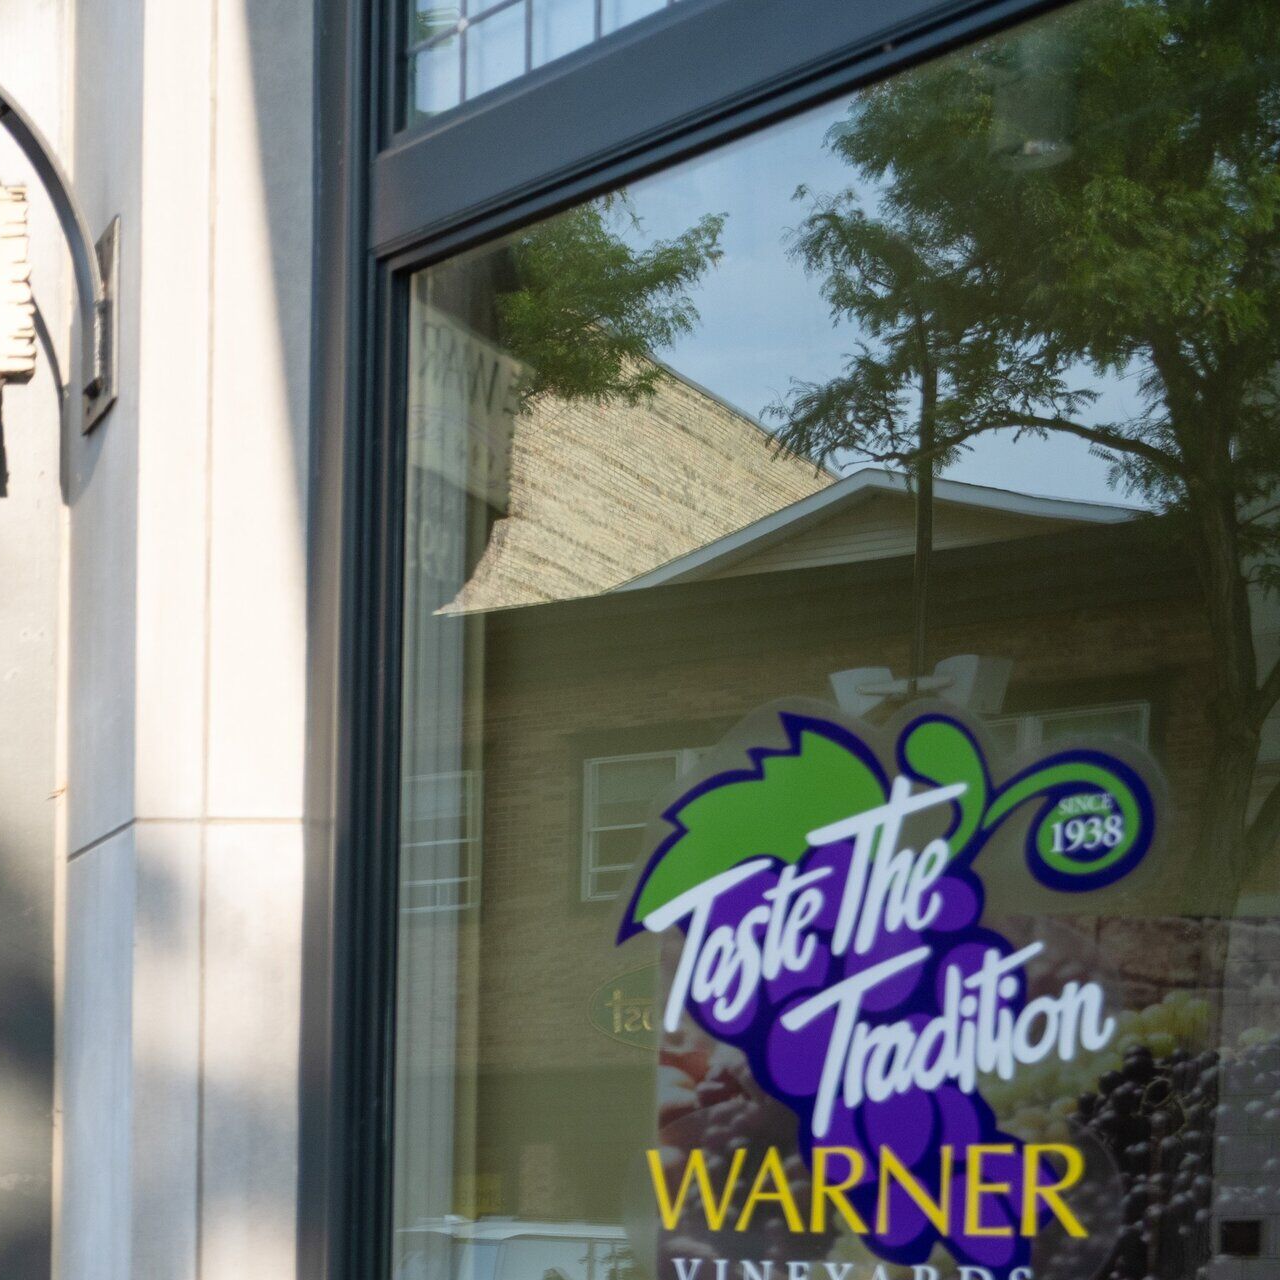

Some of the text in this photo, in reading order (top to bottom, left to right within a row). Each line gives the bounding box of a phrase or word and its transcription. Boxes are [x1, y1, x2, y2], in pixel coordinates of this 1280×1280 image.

[1050, 814, 1124, 854] 1938
[1058, 793, 1114, 815] SINCE
[642, 774, 969, 1033] Taste The
[780, 942, 1116, 1138] Tradition
[645, 1141, 1089, 1239] WARNER
